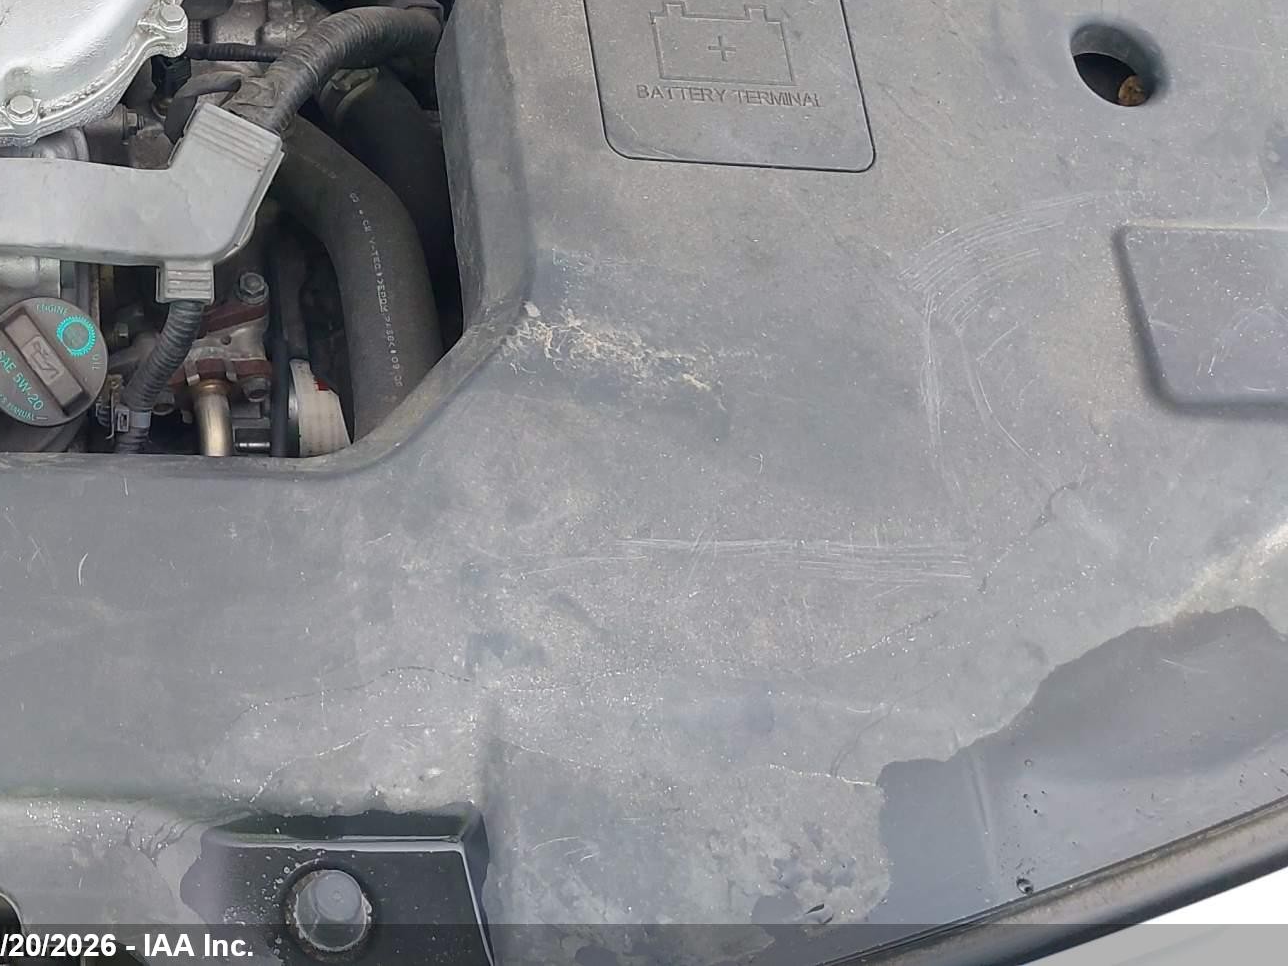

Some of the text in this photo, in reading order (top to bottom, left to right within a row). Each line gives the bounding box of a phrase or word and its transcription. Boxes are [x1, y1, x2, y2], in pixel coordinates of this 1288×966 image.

[636, 84, 823, 107] BATTERY TERMINAL
[12, 372, 44, 411] 5W-20
